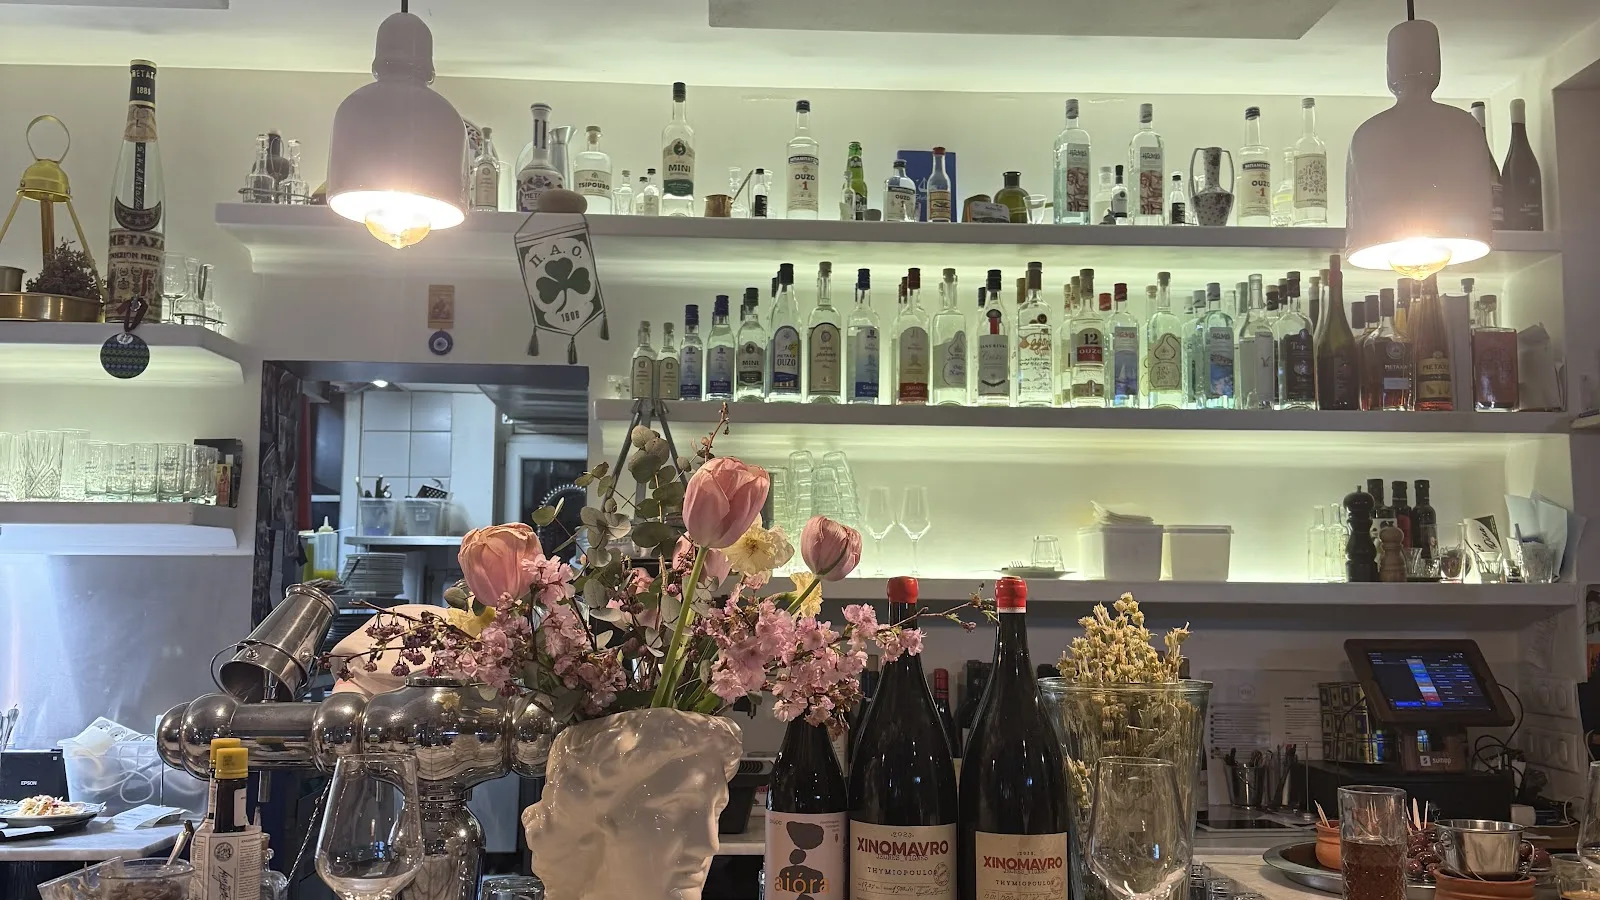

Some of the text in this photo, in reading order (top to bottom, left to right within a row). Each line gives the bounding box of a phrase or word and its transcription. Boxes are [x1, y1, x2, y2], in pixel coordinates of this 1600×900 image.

[668, 164, 691, 173] MINI
[578, 182, 610, 191] TSIPOURO
[802, 180, 808, 190] 1
[1084, 333, 1099, 345] 12
[776, 358, 796, 366] OUZO
[856, 836, 949, 856] XINOMAVRO
[983, 856, 1063, 870] XINOMAVRO
[774, 872, 830, 894] aióra
